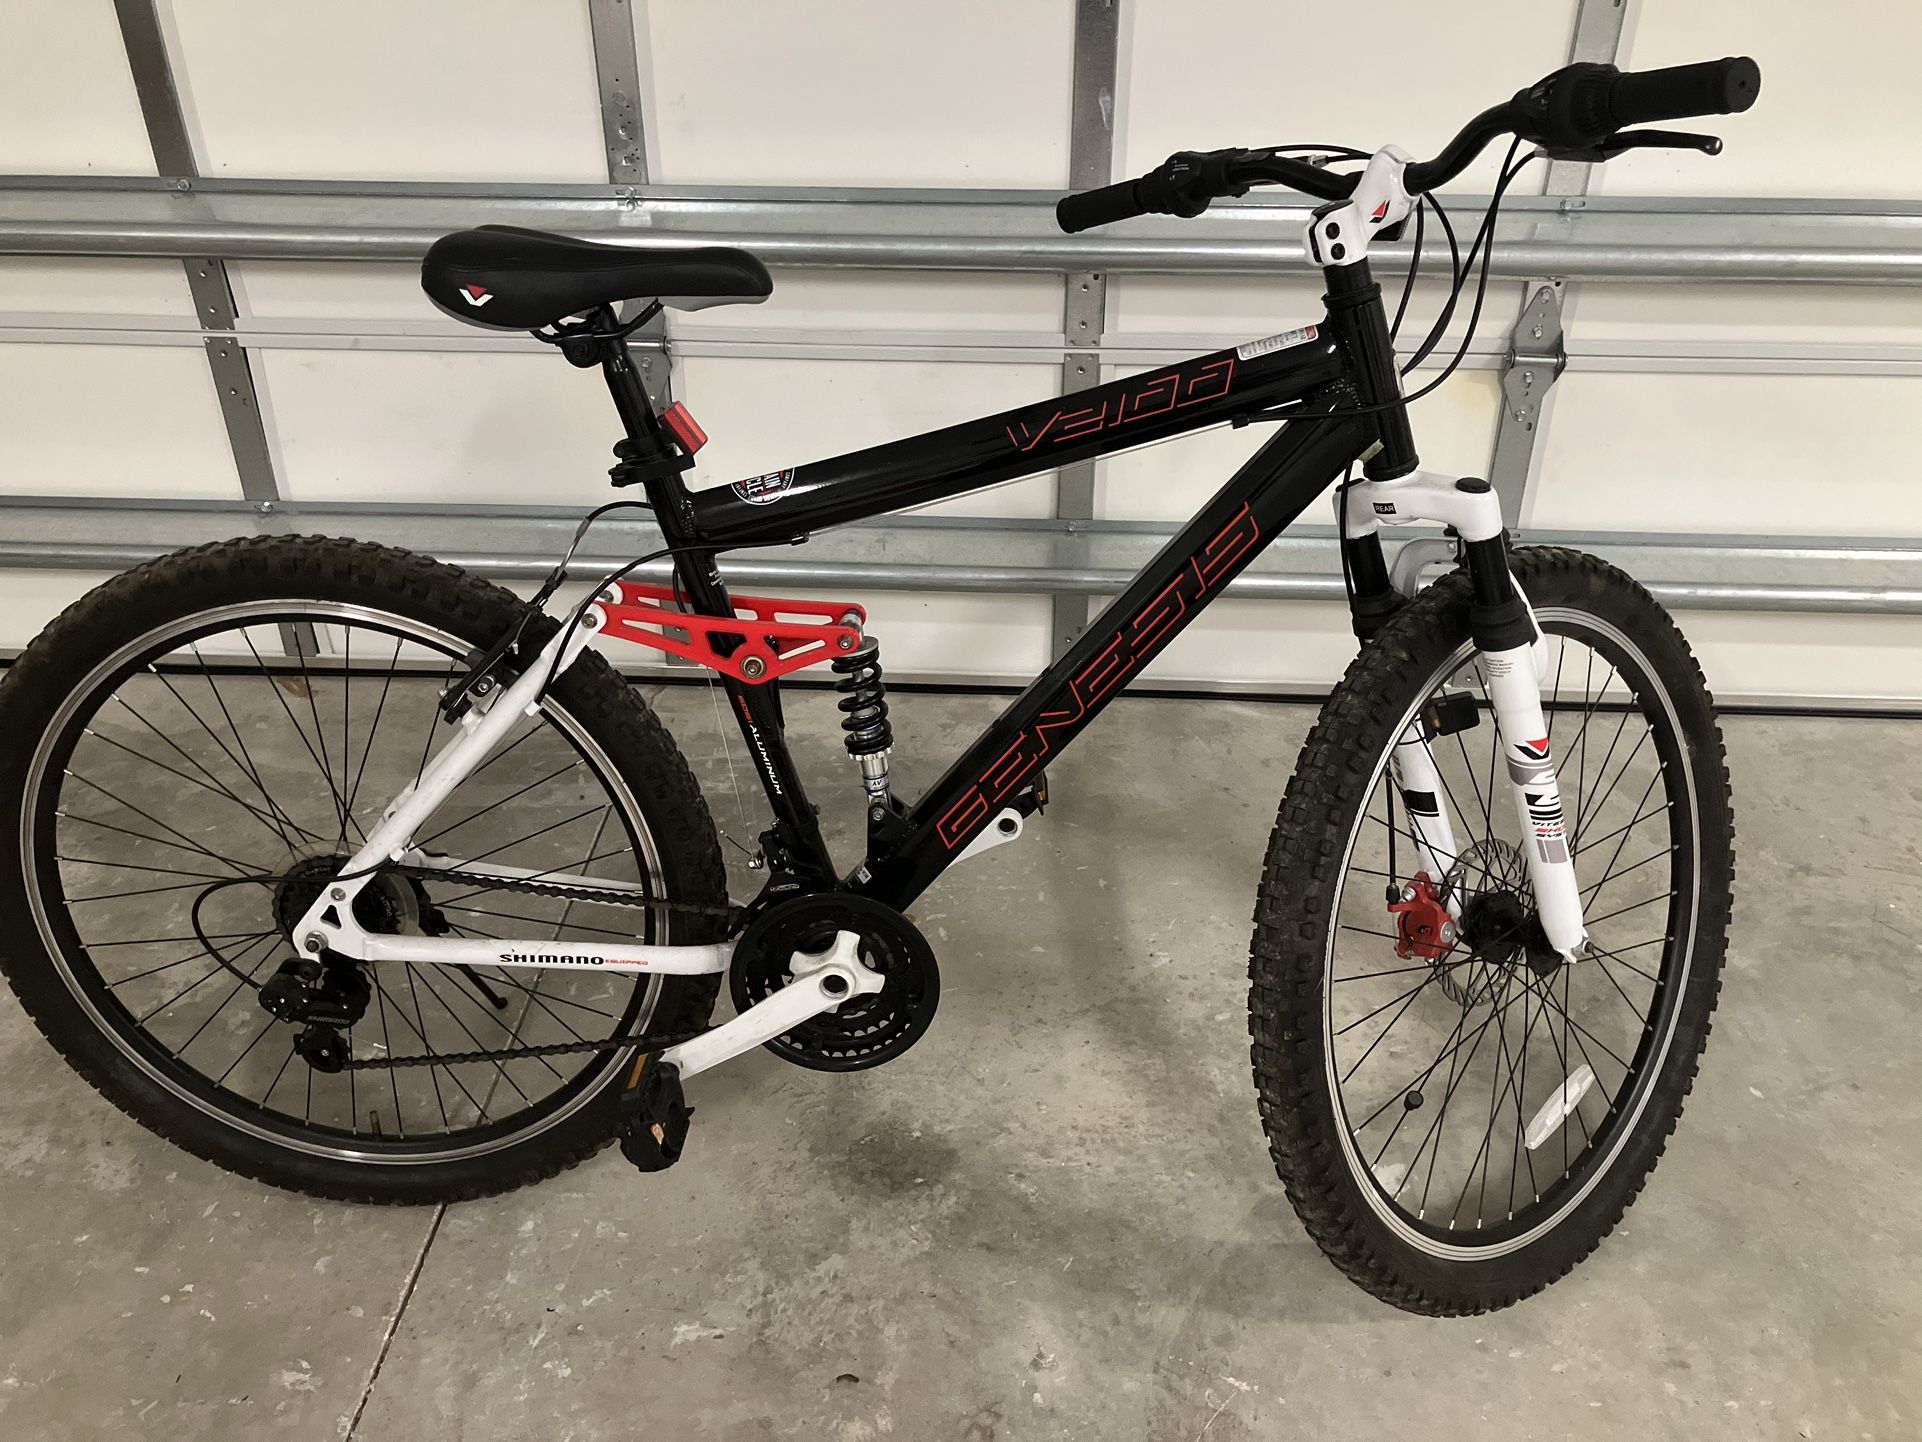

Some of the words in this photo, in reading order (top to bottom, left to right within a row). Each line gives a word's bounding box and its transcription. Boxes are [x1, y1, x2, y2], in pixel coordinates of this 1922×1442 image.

[1375, 504, 1395, 512] REAR
[937, 501, 1260, 849] GENESIS
[749, 724, 783, 794] ALUMINUM
[500, 954, 604, 965] SHIMANO
